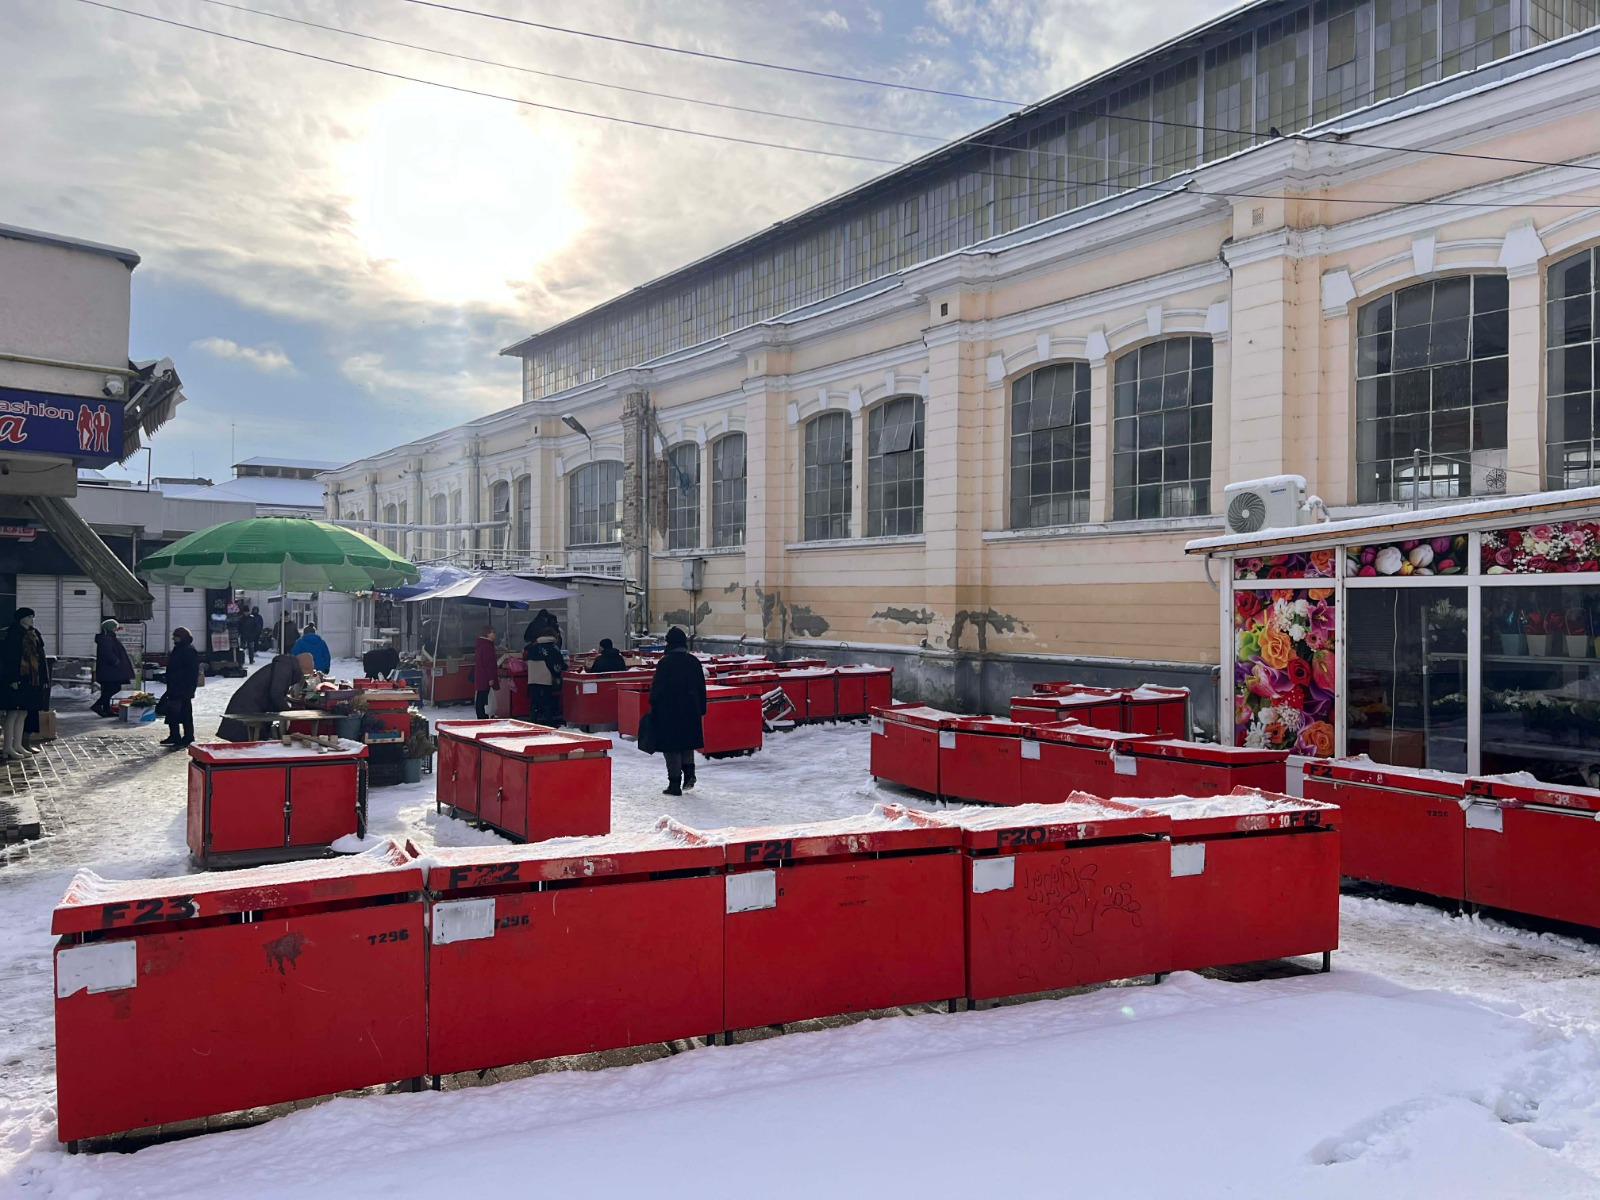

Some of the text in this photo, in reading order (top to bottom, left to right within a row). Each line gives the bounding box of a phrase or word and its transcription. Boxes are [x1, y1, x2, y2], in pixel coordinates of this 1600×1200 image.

[1311, 764, 1332, 778] F2
[998, 827, 1045, 847] F20
[744, 840, 793, 863] F21
[102, 895, 197, 928] F23
[367, 929, 410, 946] T296
